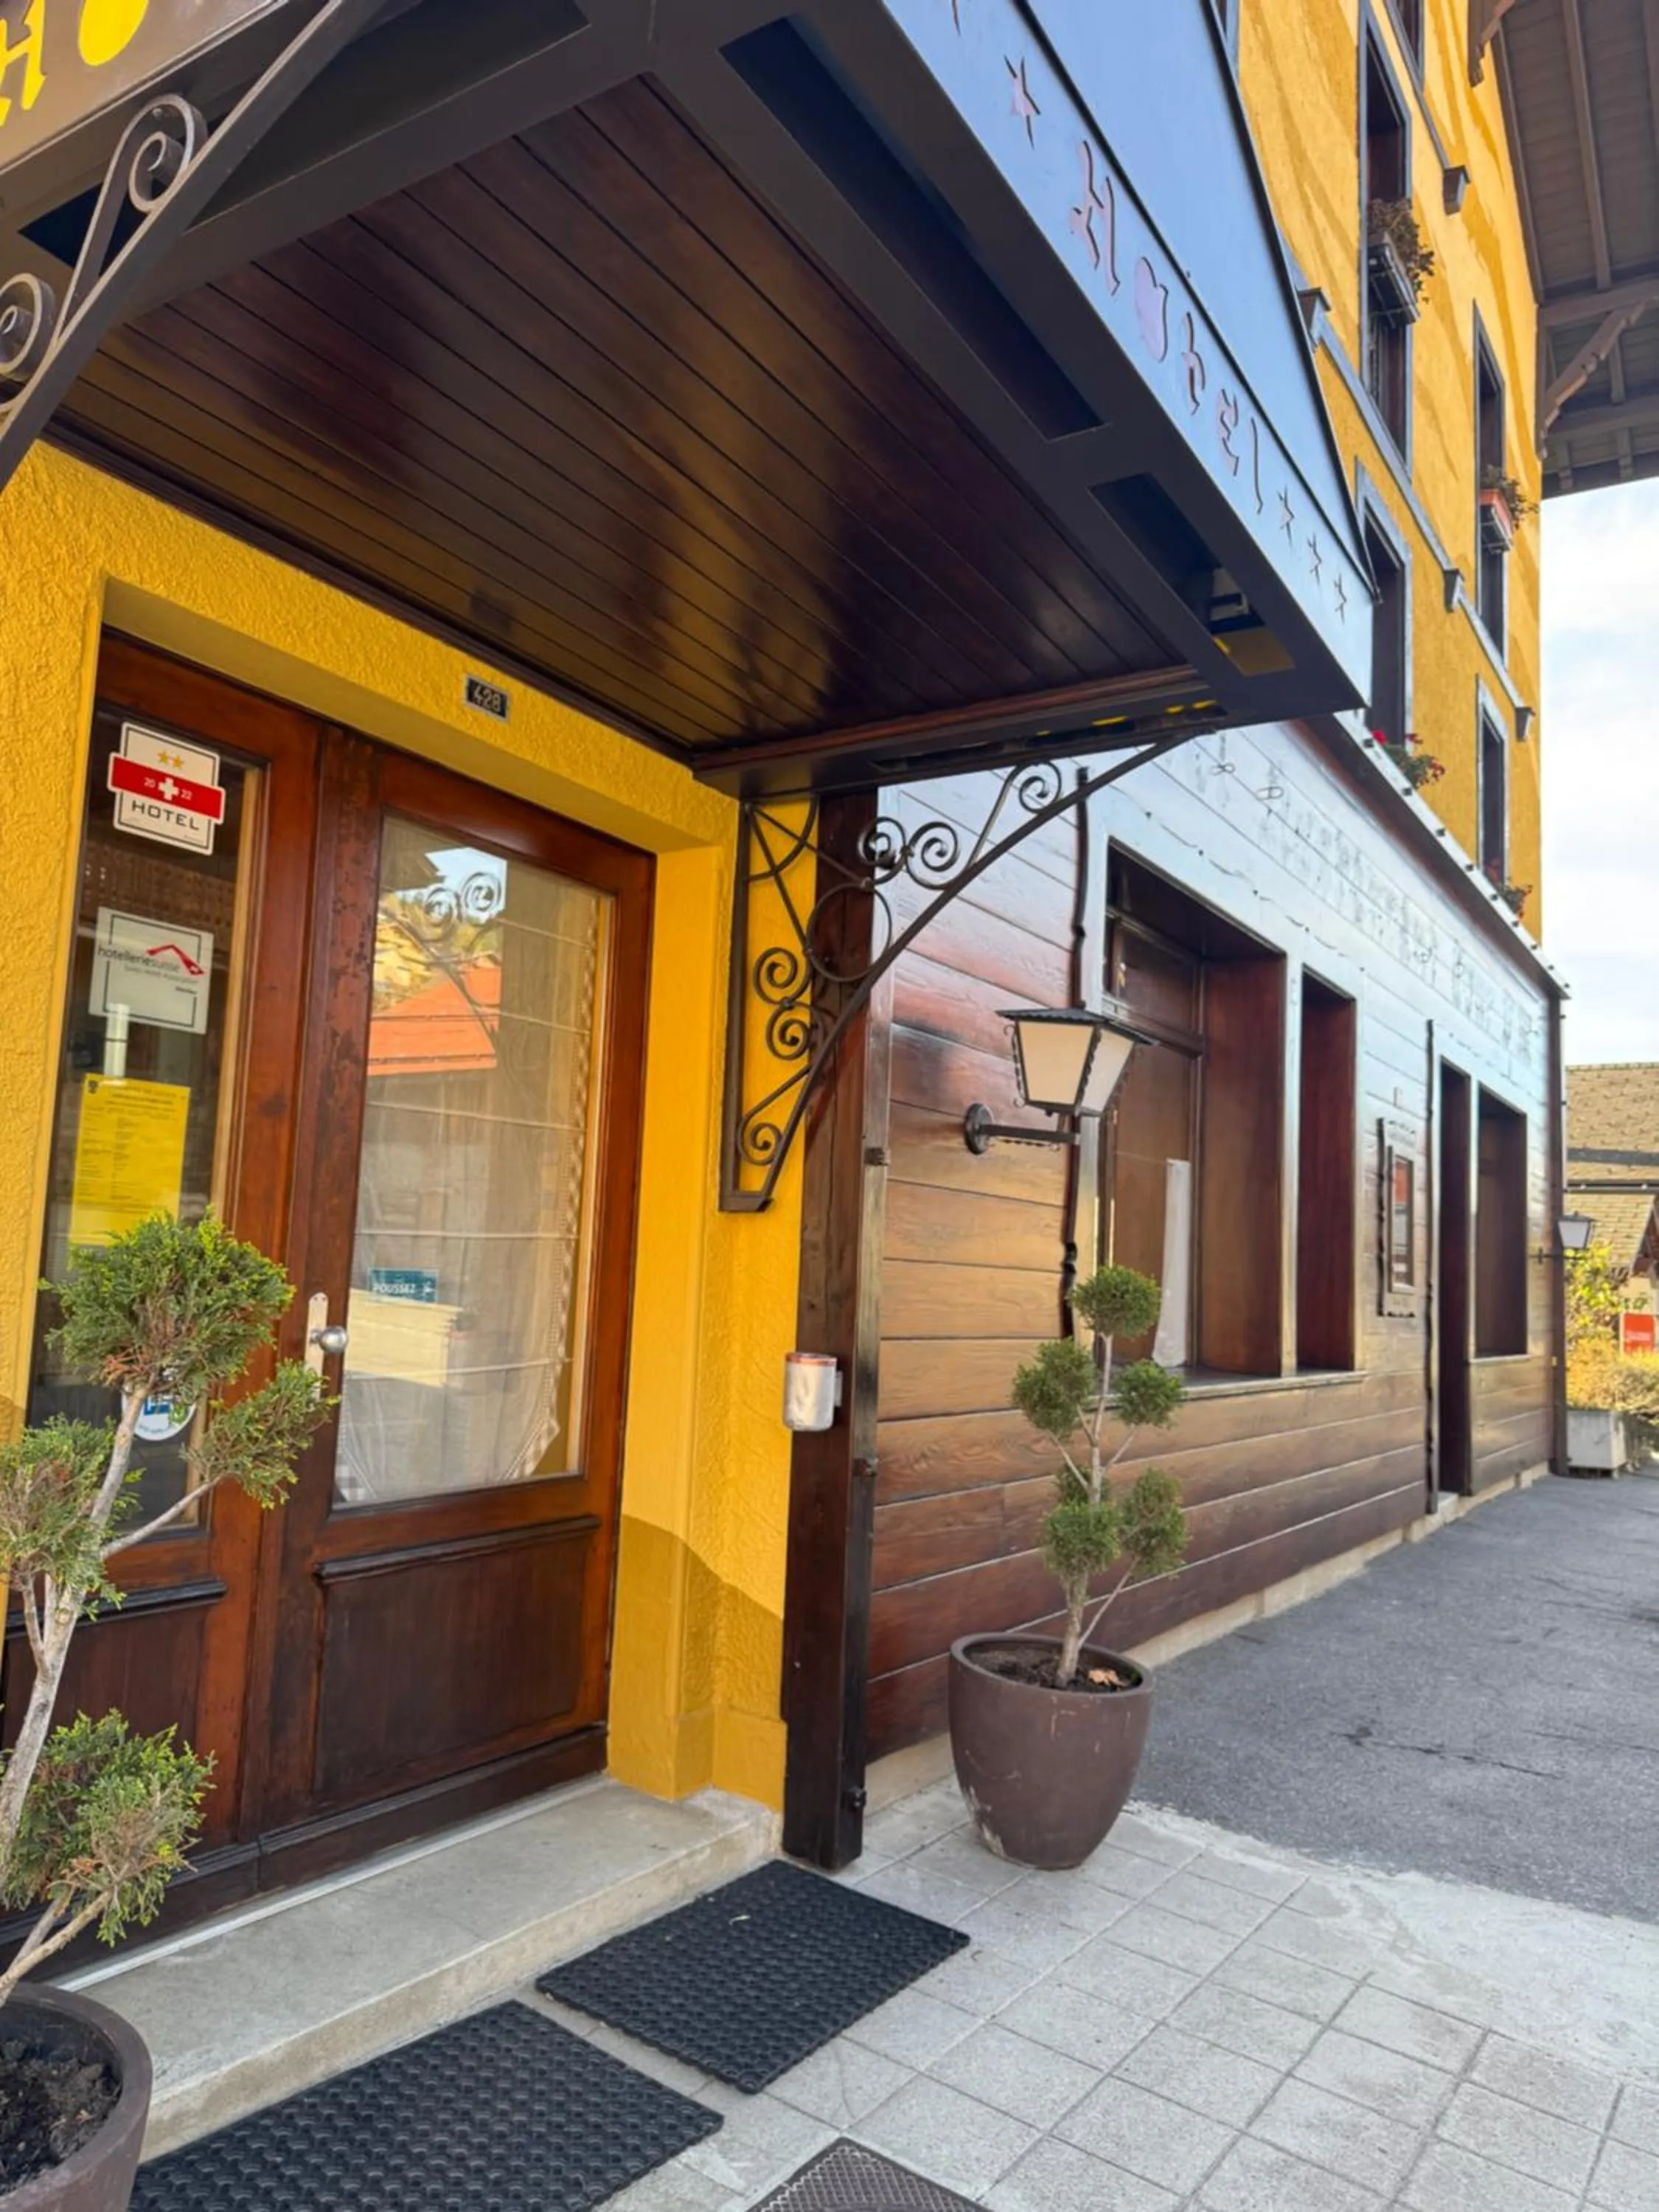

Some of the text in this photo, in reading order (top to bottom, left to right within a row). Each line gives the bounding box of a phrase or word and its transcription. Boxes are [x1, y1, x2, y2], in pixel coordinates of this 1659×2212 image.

[143, 777, 193, 801] 20 22
[132, 800, 200, 830] HOTEL
